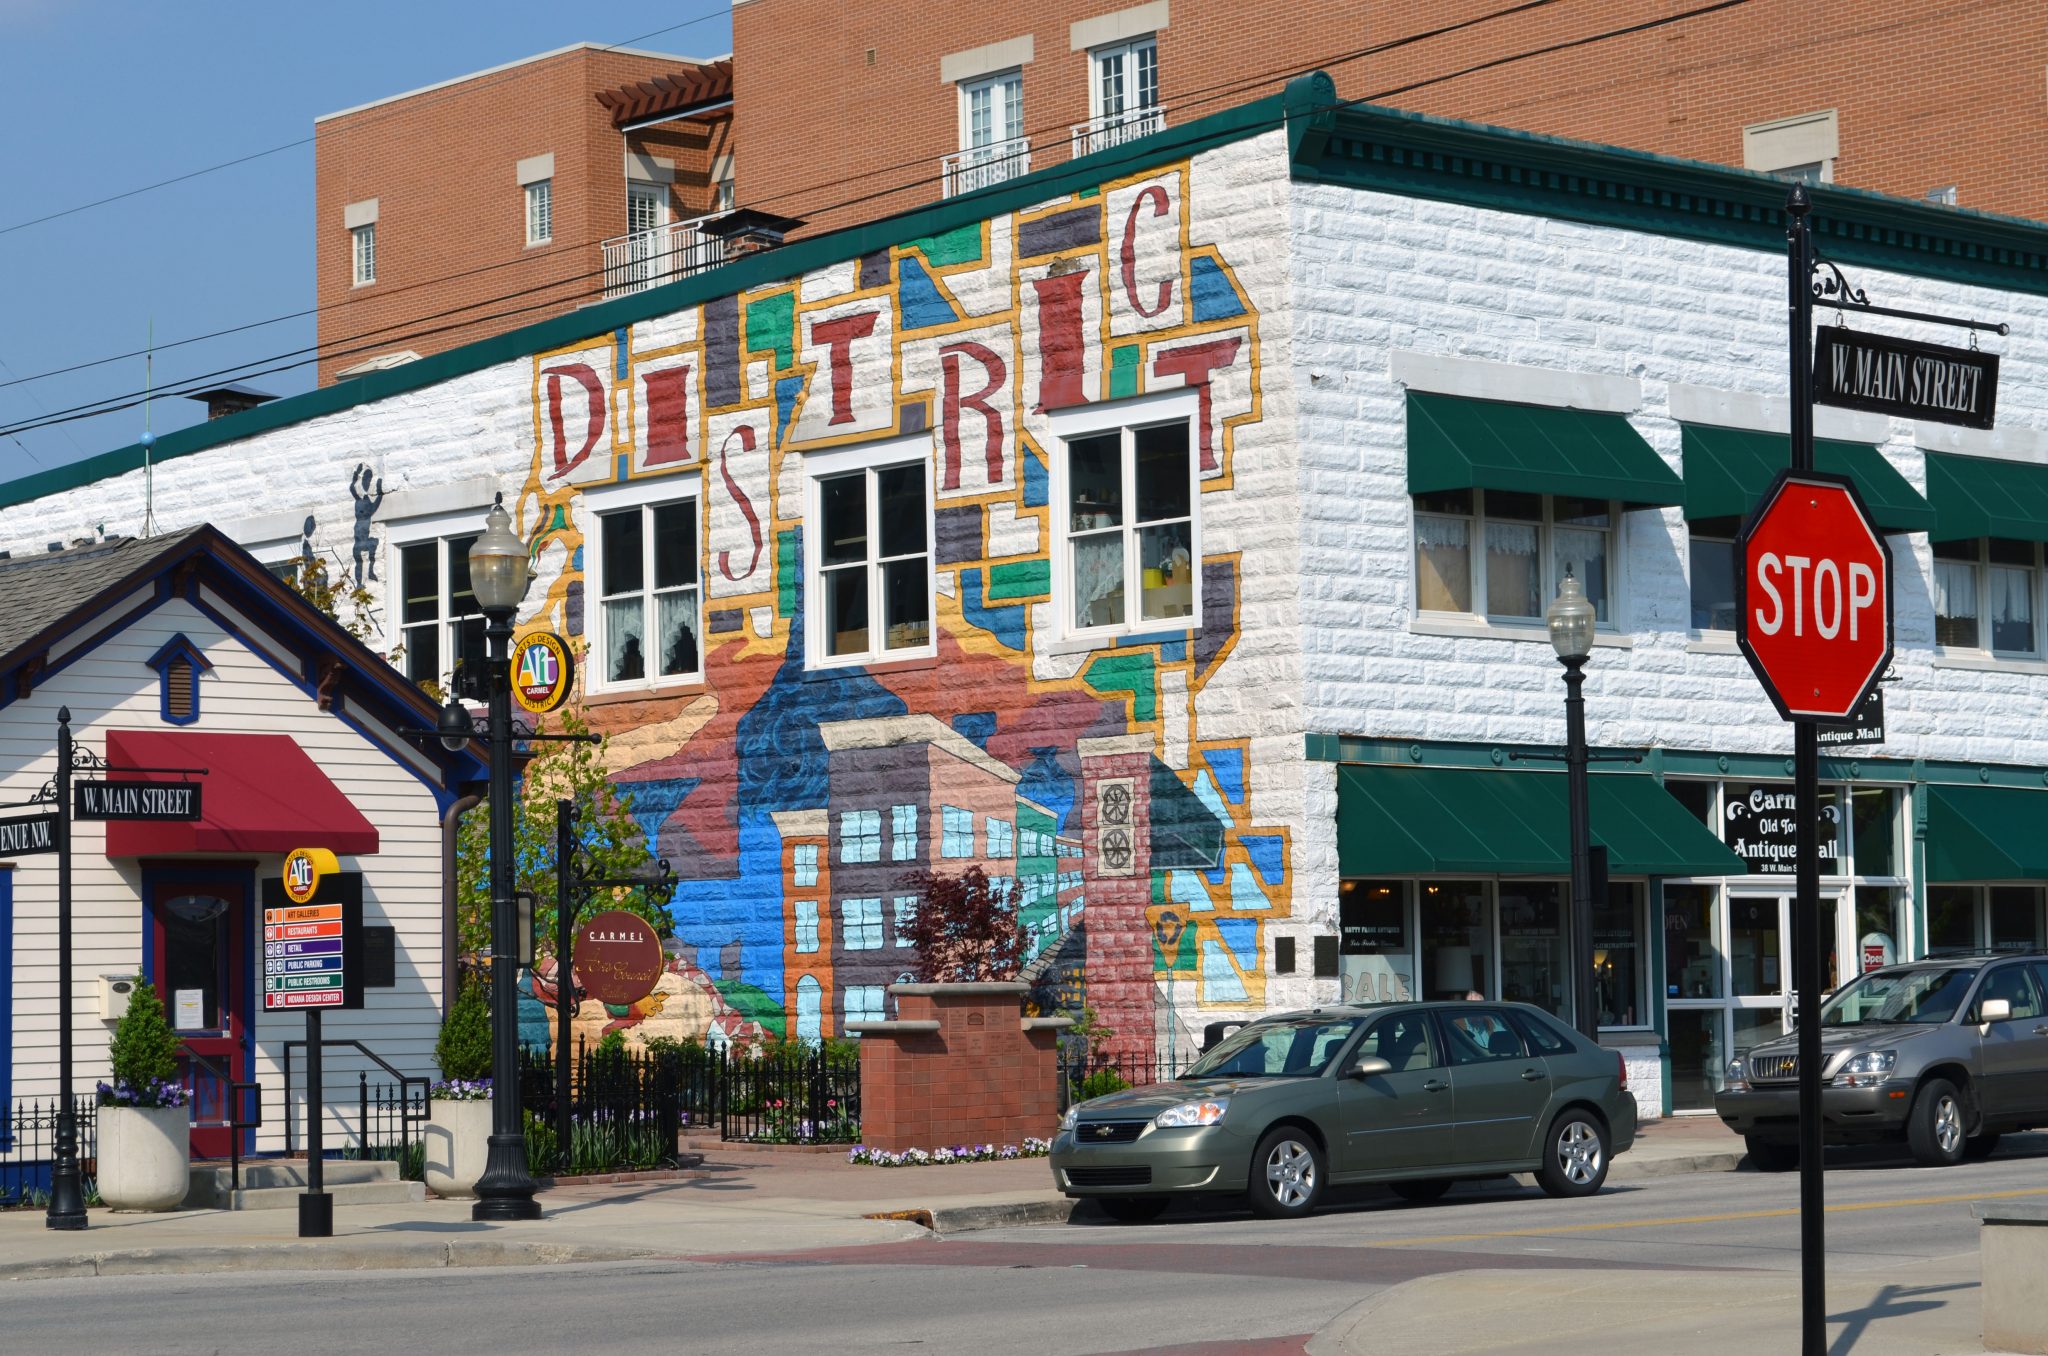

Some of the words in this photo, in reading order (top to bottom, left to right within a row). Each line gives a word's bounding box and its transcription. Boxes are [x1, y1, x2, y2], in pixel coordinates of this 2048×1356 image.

[541, 185, 1241, 582] DISTRICT
[1832, 343, 1849, 394] W.
[1852, 347, 1908, 402] MAIN
[1910, 356, 1982, 413] STREET
[1755, 552, 1876, 641] STOP
[516, 639, 531, 660] ARTS
[537, 635, 561, 656] DESIGN
[519, 645, 557, 687] Art
[526, 687, 550, 695] CARMEL
[524, 694, 555, 709] DISTRICT
[1856, 727, 1881, 740] Mall
[84, 787, 98, 813] W.
[102, 788, 138, 814] MAIN
[142, 788, 192, 815] STREET
[1750, 789, 1796, 813] Carm
[1760, 818, 1778, 834] Old
[0, 824, 28, 851] ENUE
[31, 821, 52, 848] N.W.
[1734, 838, 1797, 862] Antique
[1818, 840, 1838, 859] all
[289, 858, 312, 886] Art
[1761, 864, 1768, 872] 38
[1769, 864, 1777, 872] W.
[1778, 864, 1792, 872] Main
[288, 911, 296, 919] ART
[297, 909, 319, 918] GALLERIES
[288, 926, 318, 935] RESTAURANTS
[589, 931, 643, 940] CARMEL
[288, 944, 303, 952] RETAIL
[288, 961, 303, 969] PUBLIC
[304, 960, 323, 968] PARKING
[1865, 953, 1884, 965] Open
[288, 978, 303, 986] PUBLIC
[304, 977, 330, 986] RESTROOMS
[1340, 972, 1410, 1002] SALE
[288, 995, 305, 1003] INDIANA
[306, 994, 321, 1003] DESIGN
[322, 993, 339, 1002] CENTER
